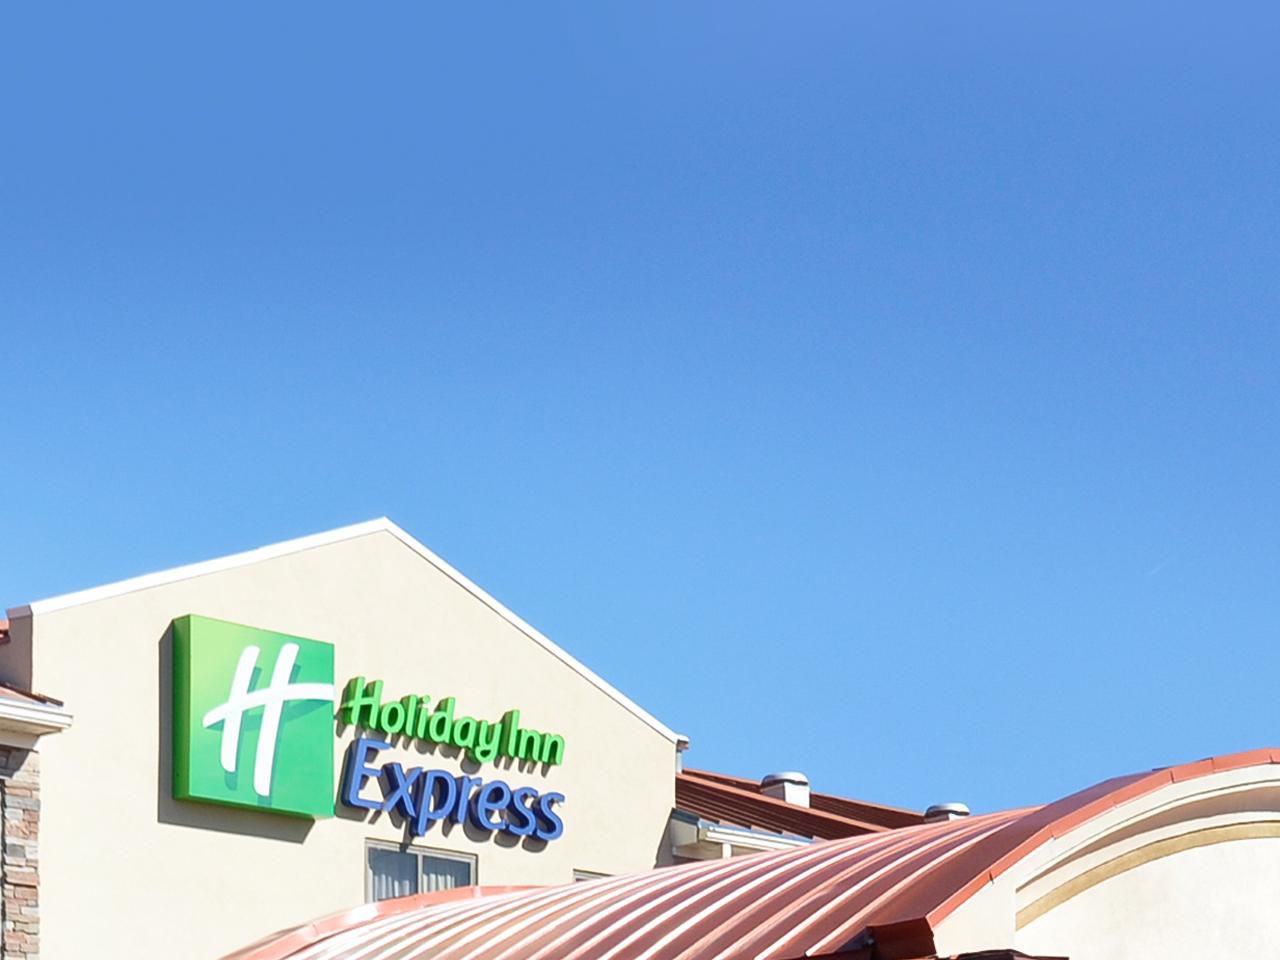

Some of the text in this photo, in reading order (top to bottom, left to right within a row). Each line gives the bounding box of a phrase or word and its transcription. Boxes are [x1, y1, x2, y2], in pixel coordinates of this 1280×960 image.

[341, 676, 565, 766] Holiday Inn
[347, 737, 566, 842] Express
